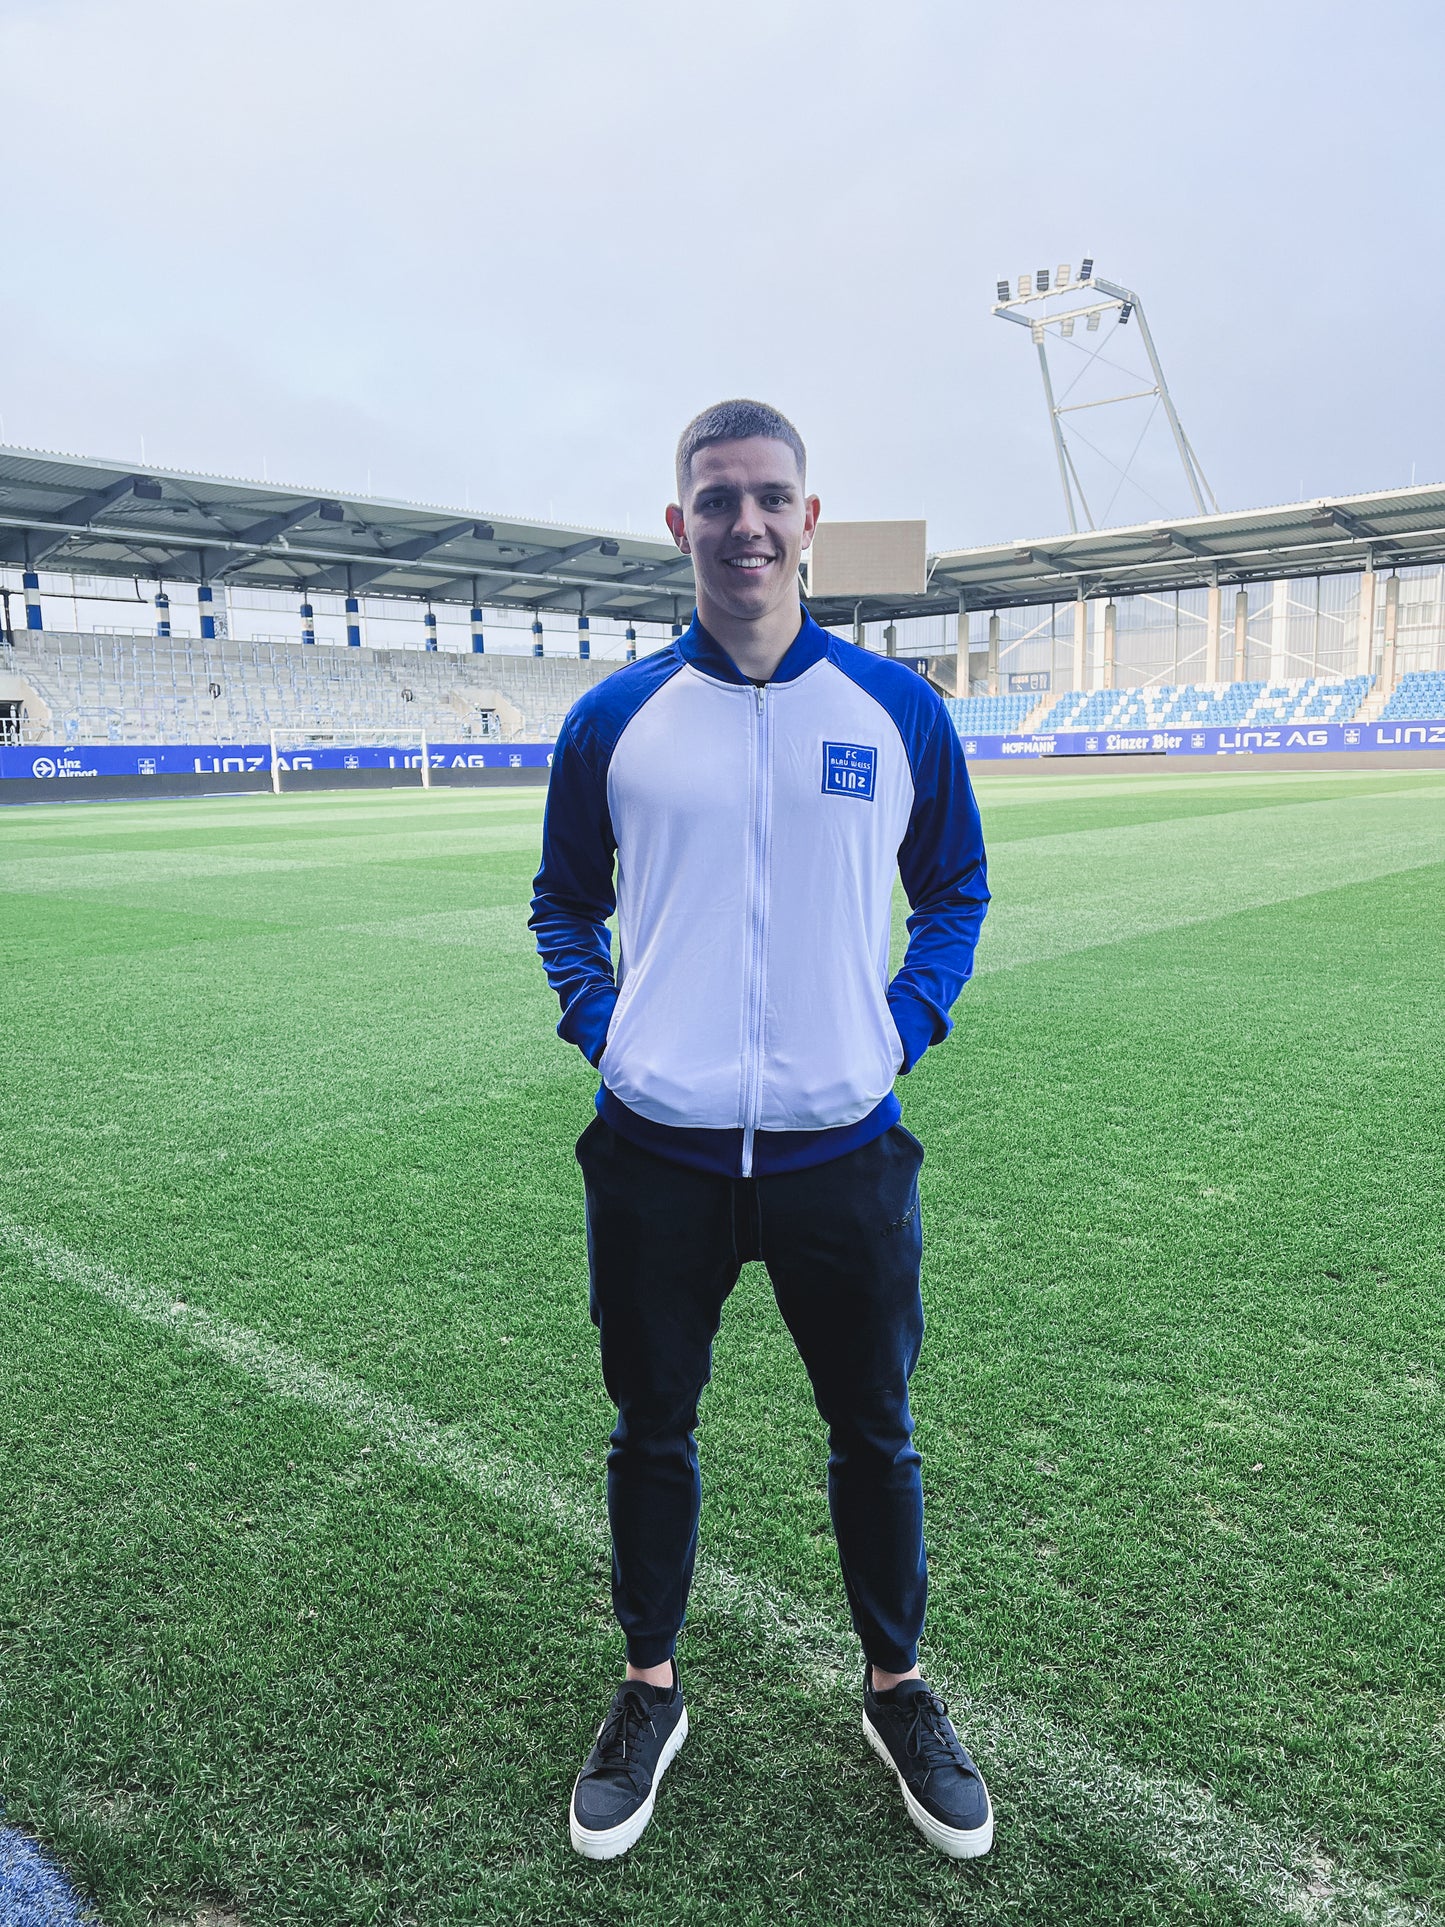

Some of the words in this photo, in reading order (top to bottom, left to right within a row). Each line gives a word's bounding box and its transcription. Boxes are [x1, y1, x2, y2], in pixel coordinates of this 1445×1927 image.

[1105, 734, 1150, 750] Linzer
[1152, 732, 1183, 749] Bier
[1219, 731, 1281, 748] LINZ
[1286, 730, 1328, 746] AG
[1376, 727, 1445, 744] LINZ
[845, 750, 857, 759] FC
[1002, 741, 1056, 754] HOFMANN
[57, 758, 81, 769] Linz
[194, 756, 265, 774] LINZ
[451, 755, 484, 768] AG
[831, 758, 849, 766] BLAU
[850, 760, 871, 770] WEISS
[835, 771, 866, 789] LINZ
